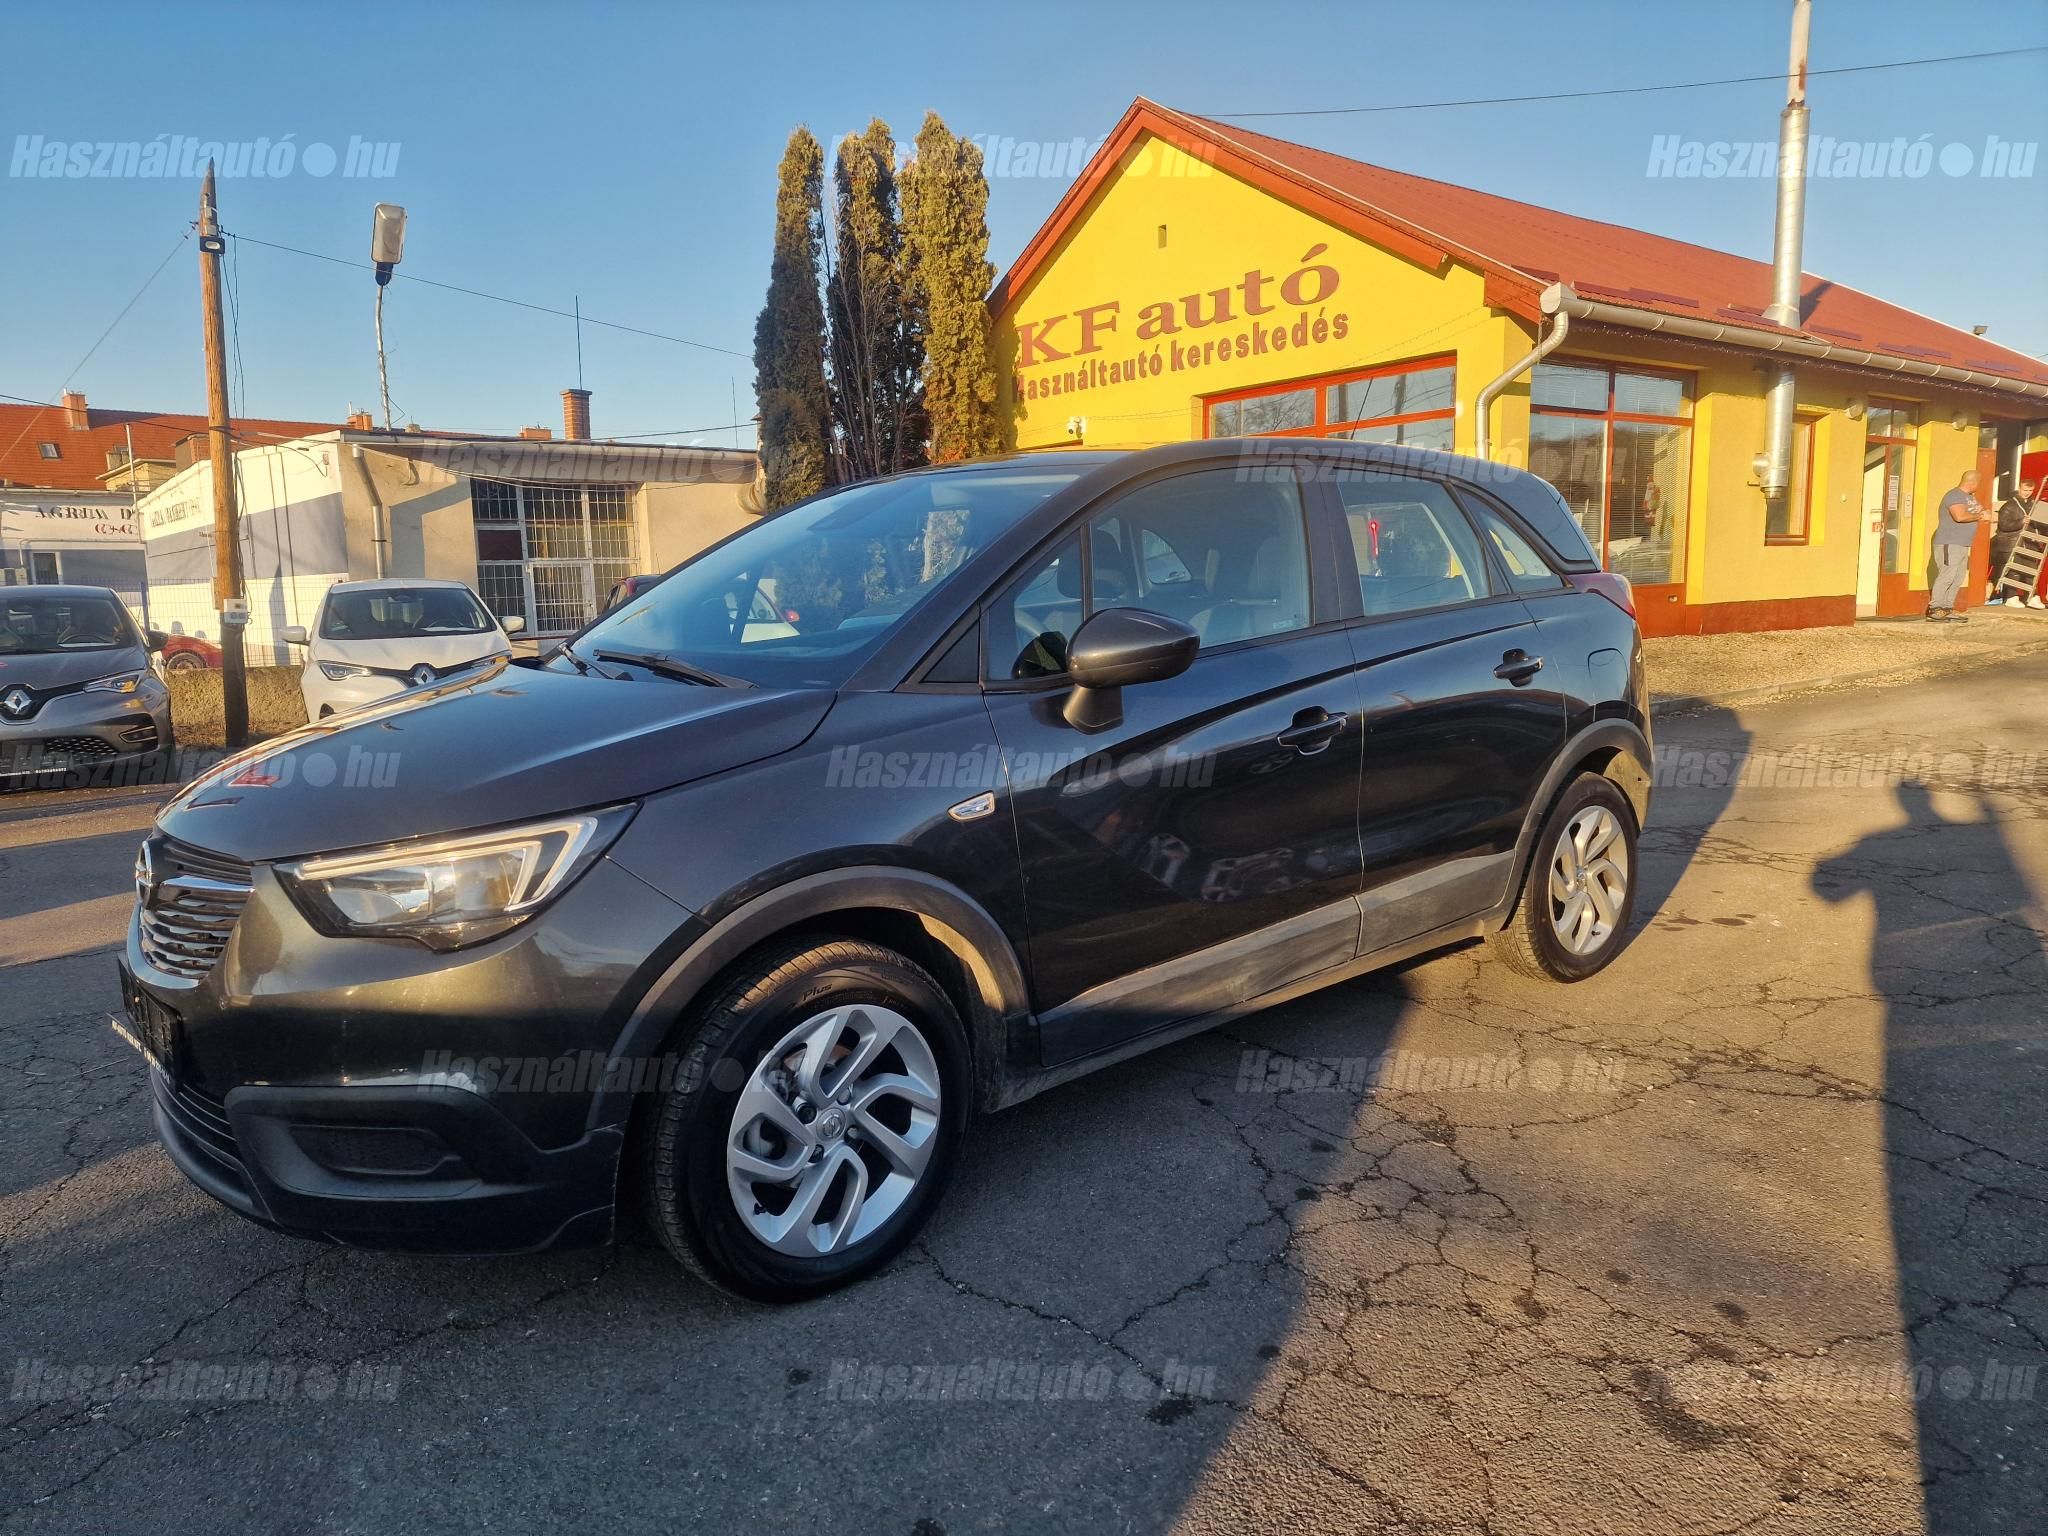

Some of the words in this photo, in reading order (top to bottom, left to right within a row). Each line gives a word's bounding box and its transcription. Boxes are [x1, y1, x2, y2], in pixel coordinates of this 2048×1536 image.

[1015, 301, 1120, 368] KF
[1137, 243, 1339, 339] autó
[1171, 307, 1349, 371] kereskedés
